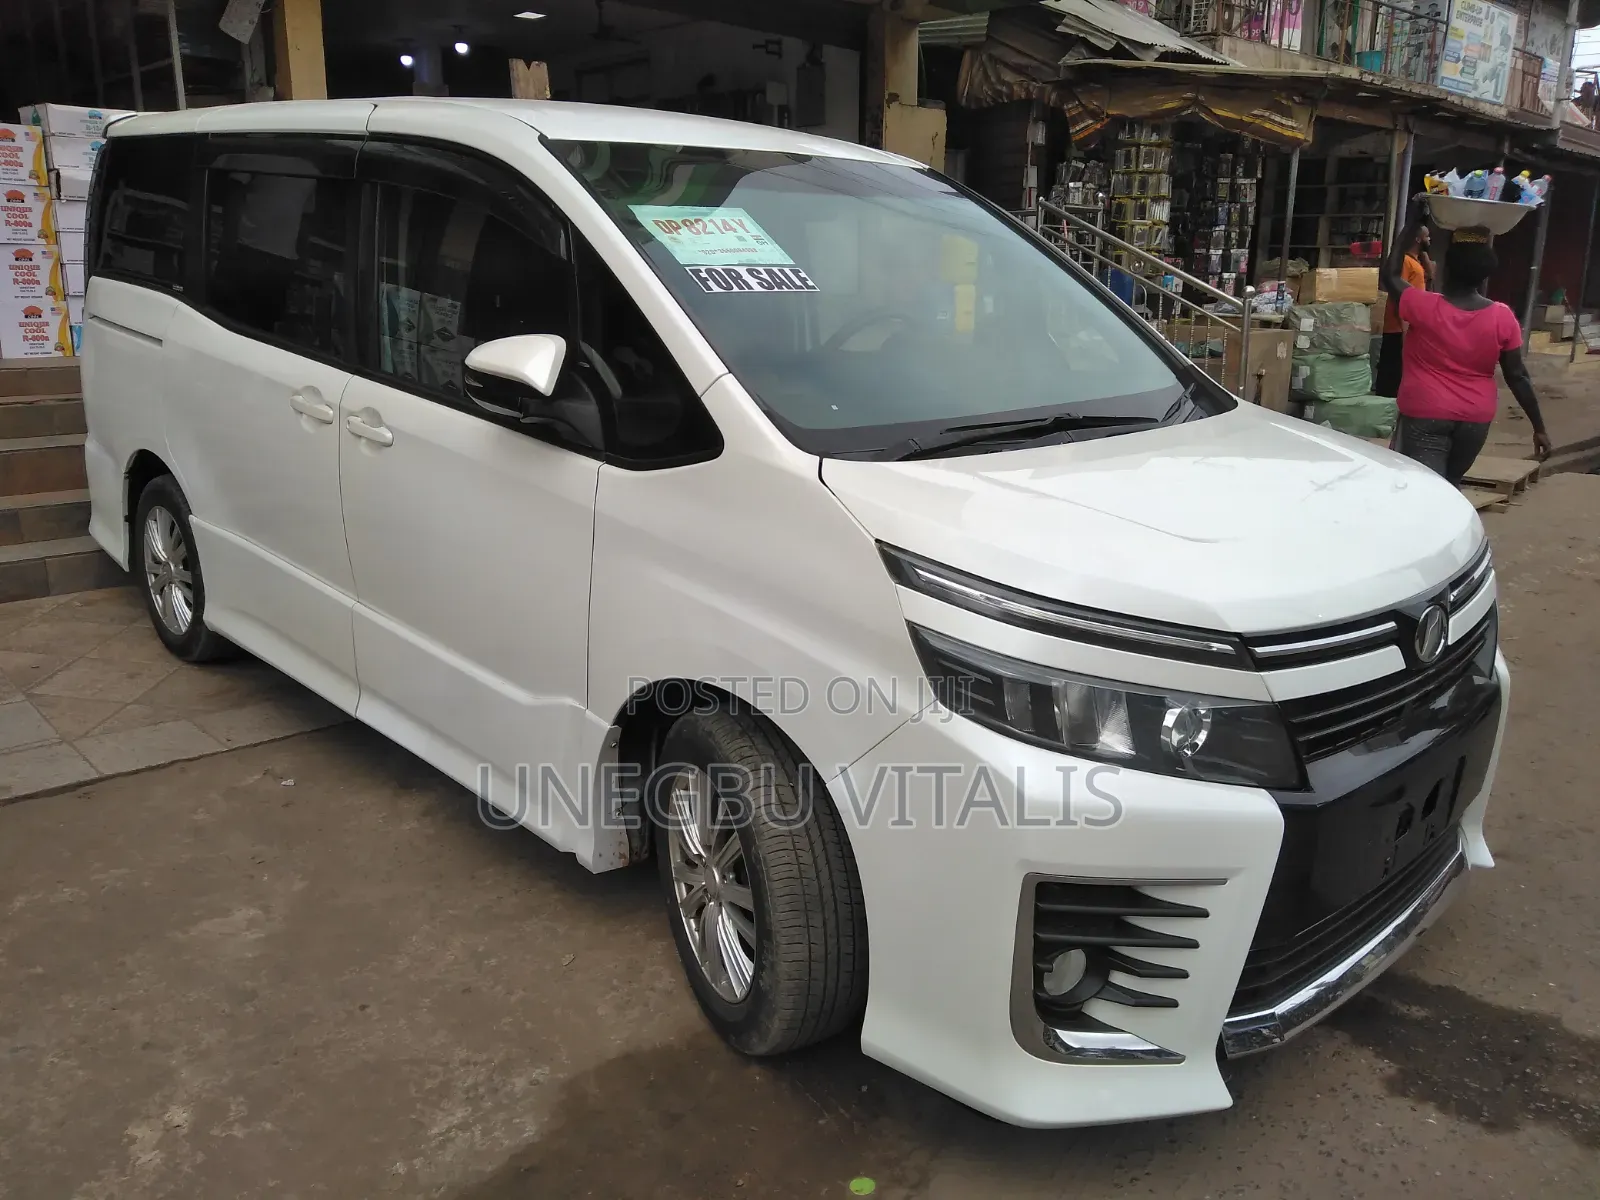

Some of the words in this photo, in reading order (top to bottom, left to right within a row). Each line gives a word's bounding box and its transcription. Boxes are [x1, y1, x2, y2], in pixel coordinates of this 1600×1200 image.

[8, 264, 41, 272] UNIQUE
[690, 268, 754, 291] FOR
[747, 268, 817, 291] SALE
